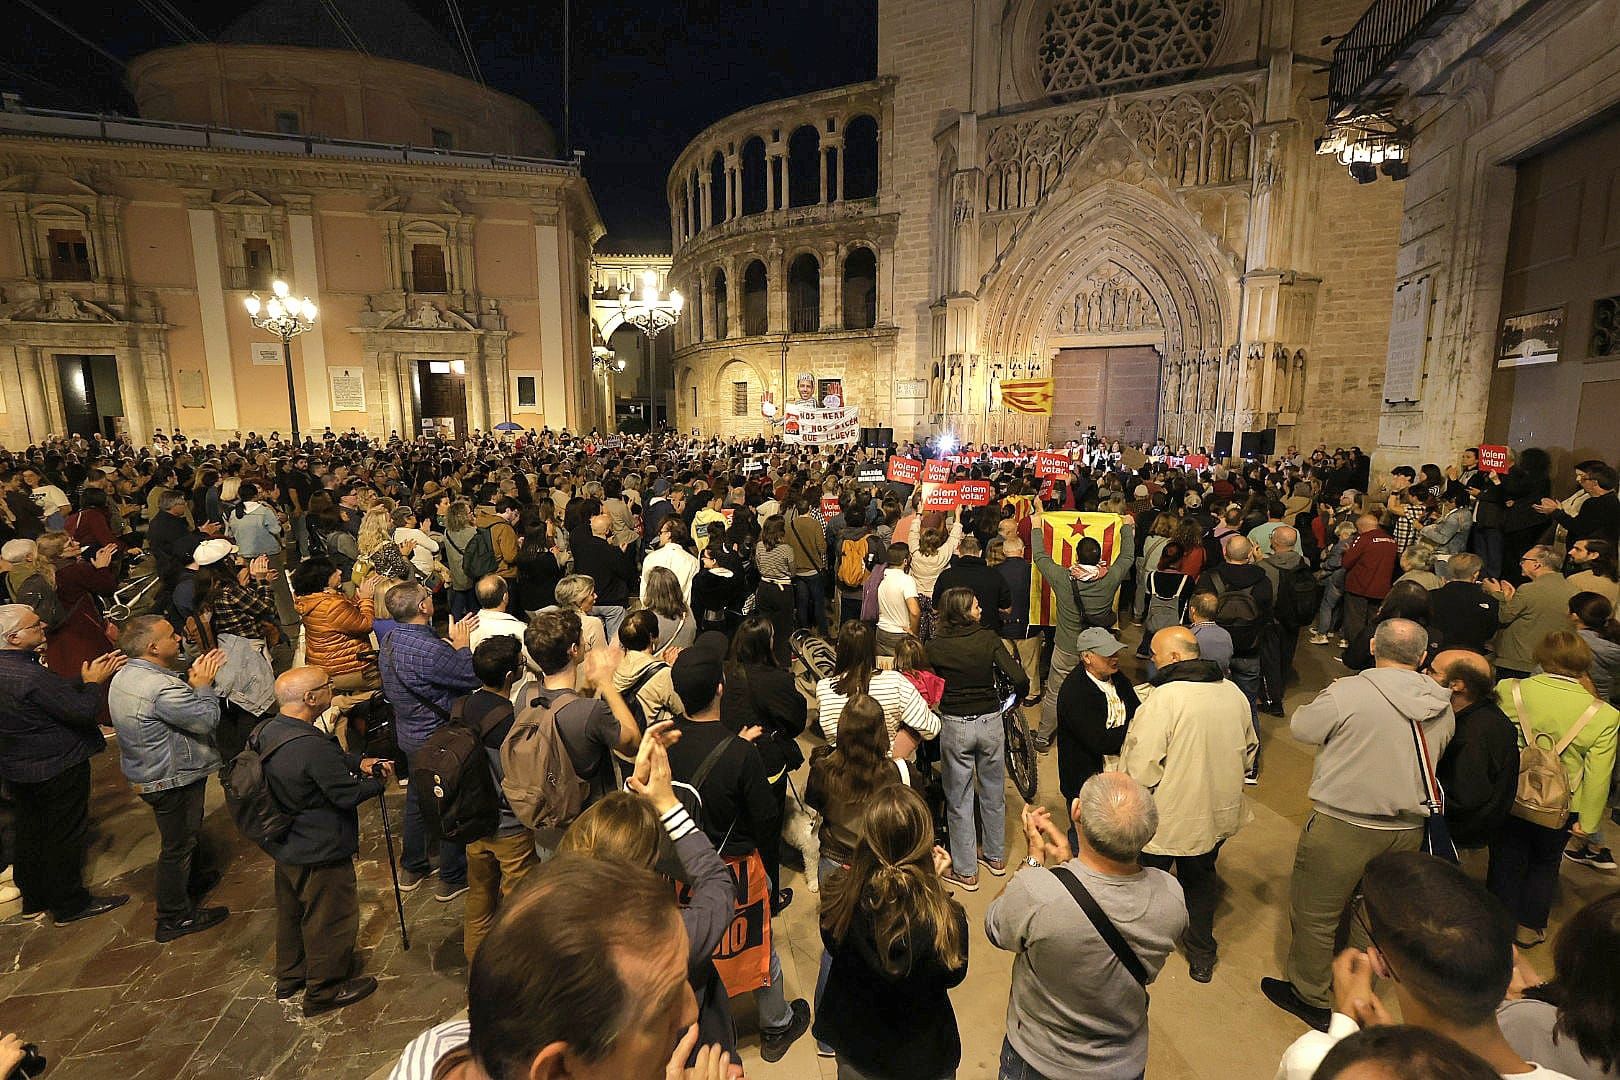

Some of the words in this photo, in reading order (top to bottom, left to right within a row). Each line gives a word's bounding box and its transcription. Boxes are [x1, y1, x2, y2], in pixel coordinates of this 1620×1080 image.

[800, 412, 815, 420] NOS
[823, 410, 845, 420] MEAN
[811, 425, 828, 433] NOS
[834, 416, 859, 430] DICEN
[802, 434, 817, 442] QUE
[826, 429, 856, 441] LLUEVE
[1481, 449, 1506, 460] Volem
[893, 460, 919, 473] Volem
[1040, 456, 1069, 468] Volem
[1482, 459, 1505, 468] votar.
[892, 468, 916, 480] votar.
[1041, 466, 1067, 475] votar.
[927, 497, 954, 505] votar.
